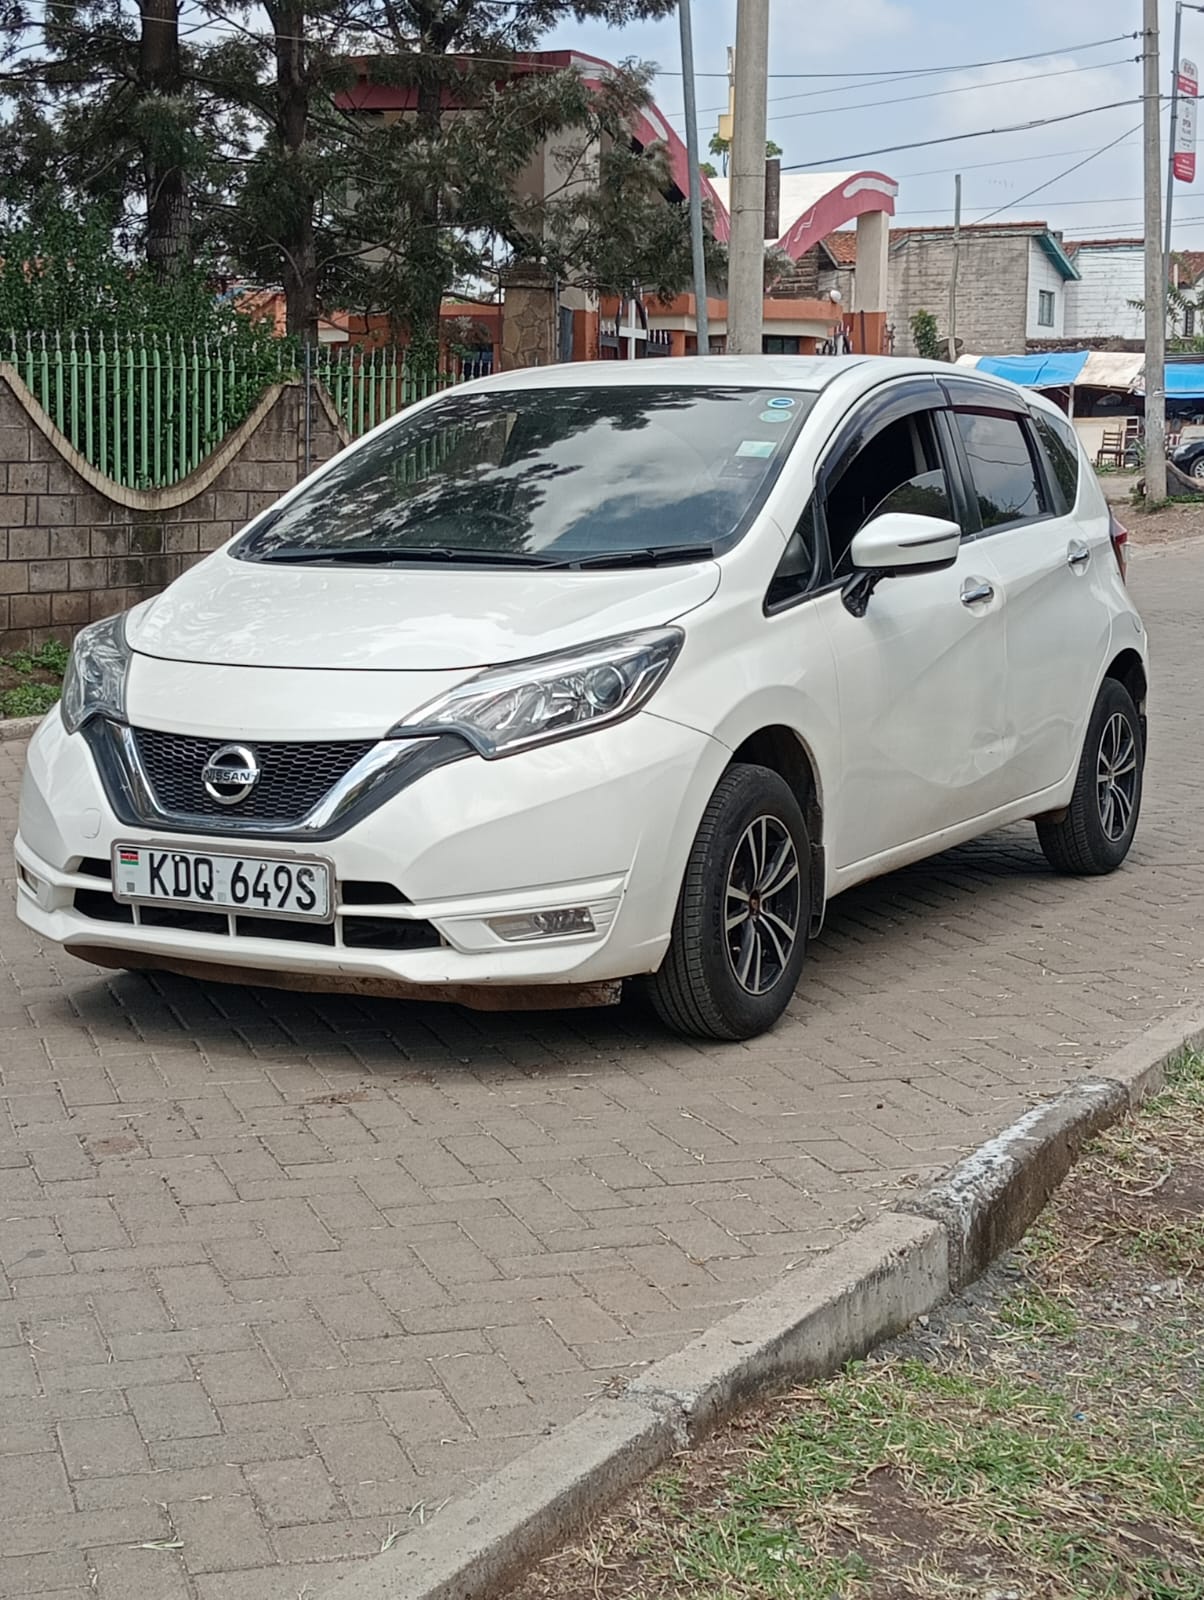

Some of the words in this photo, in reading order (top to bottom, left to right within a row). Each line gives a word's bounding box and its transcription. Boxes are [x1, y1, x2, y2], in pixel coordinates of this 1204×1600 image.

[204, 769, 251, 781] NISSAN
[149, 853, 214, 901] KDQ
[231, 861, 317, 911] 649S
